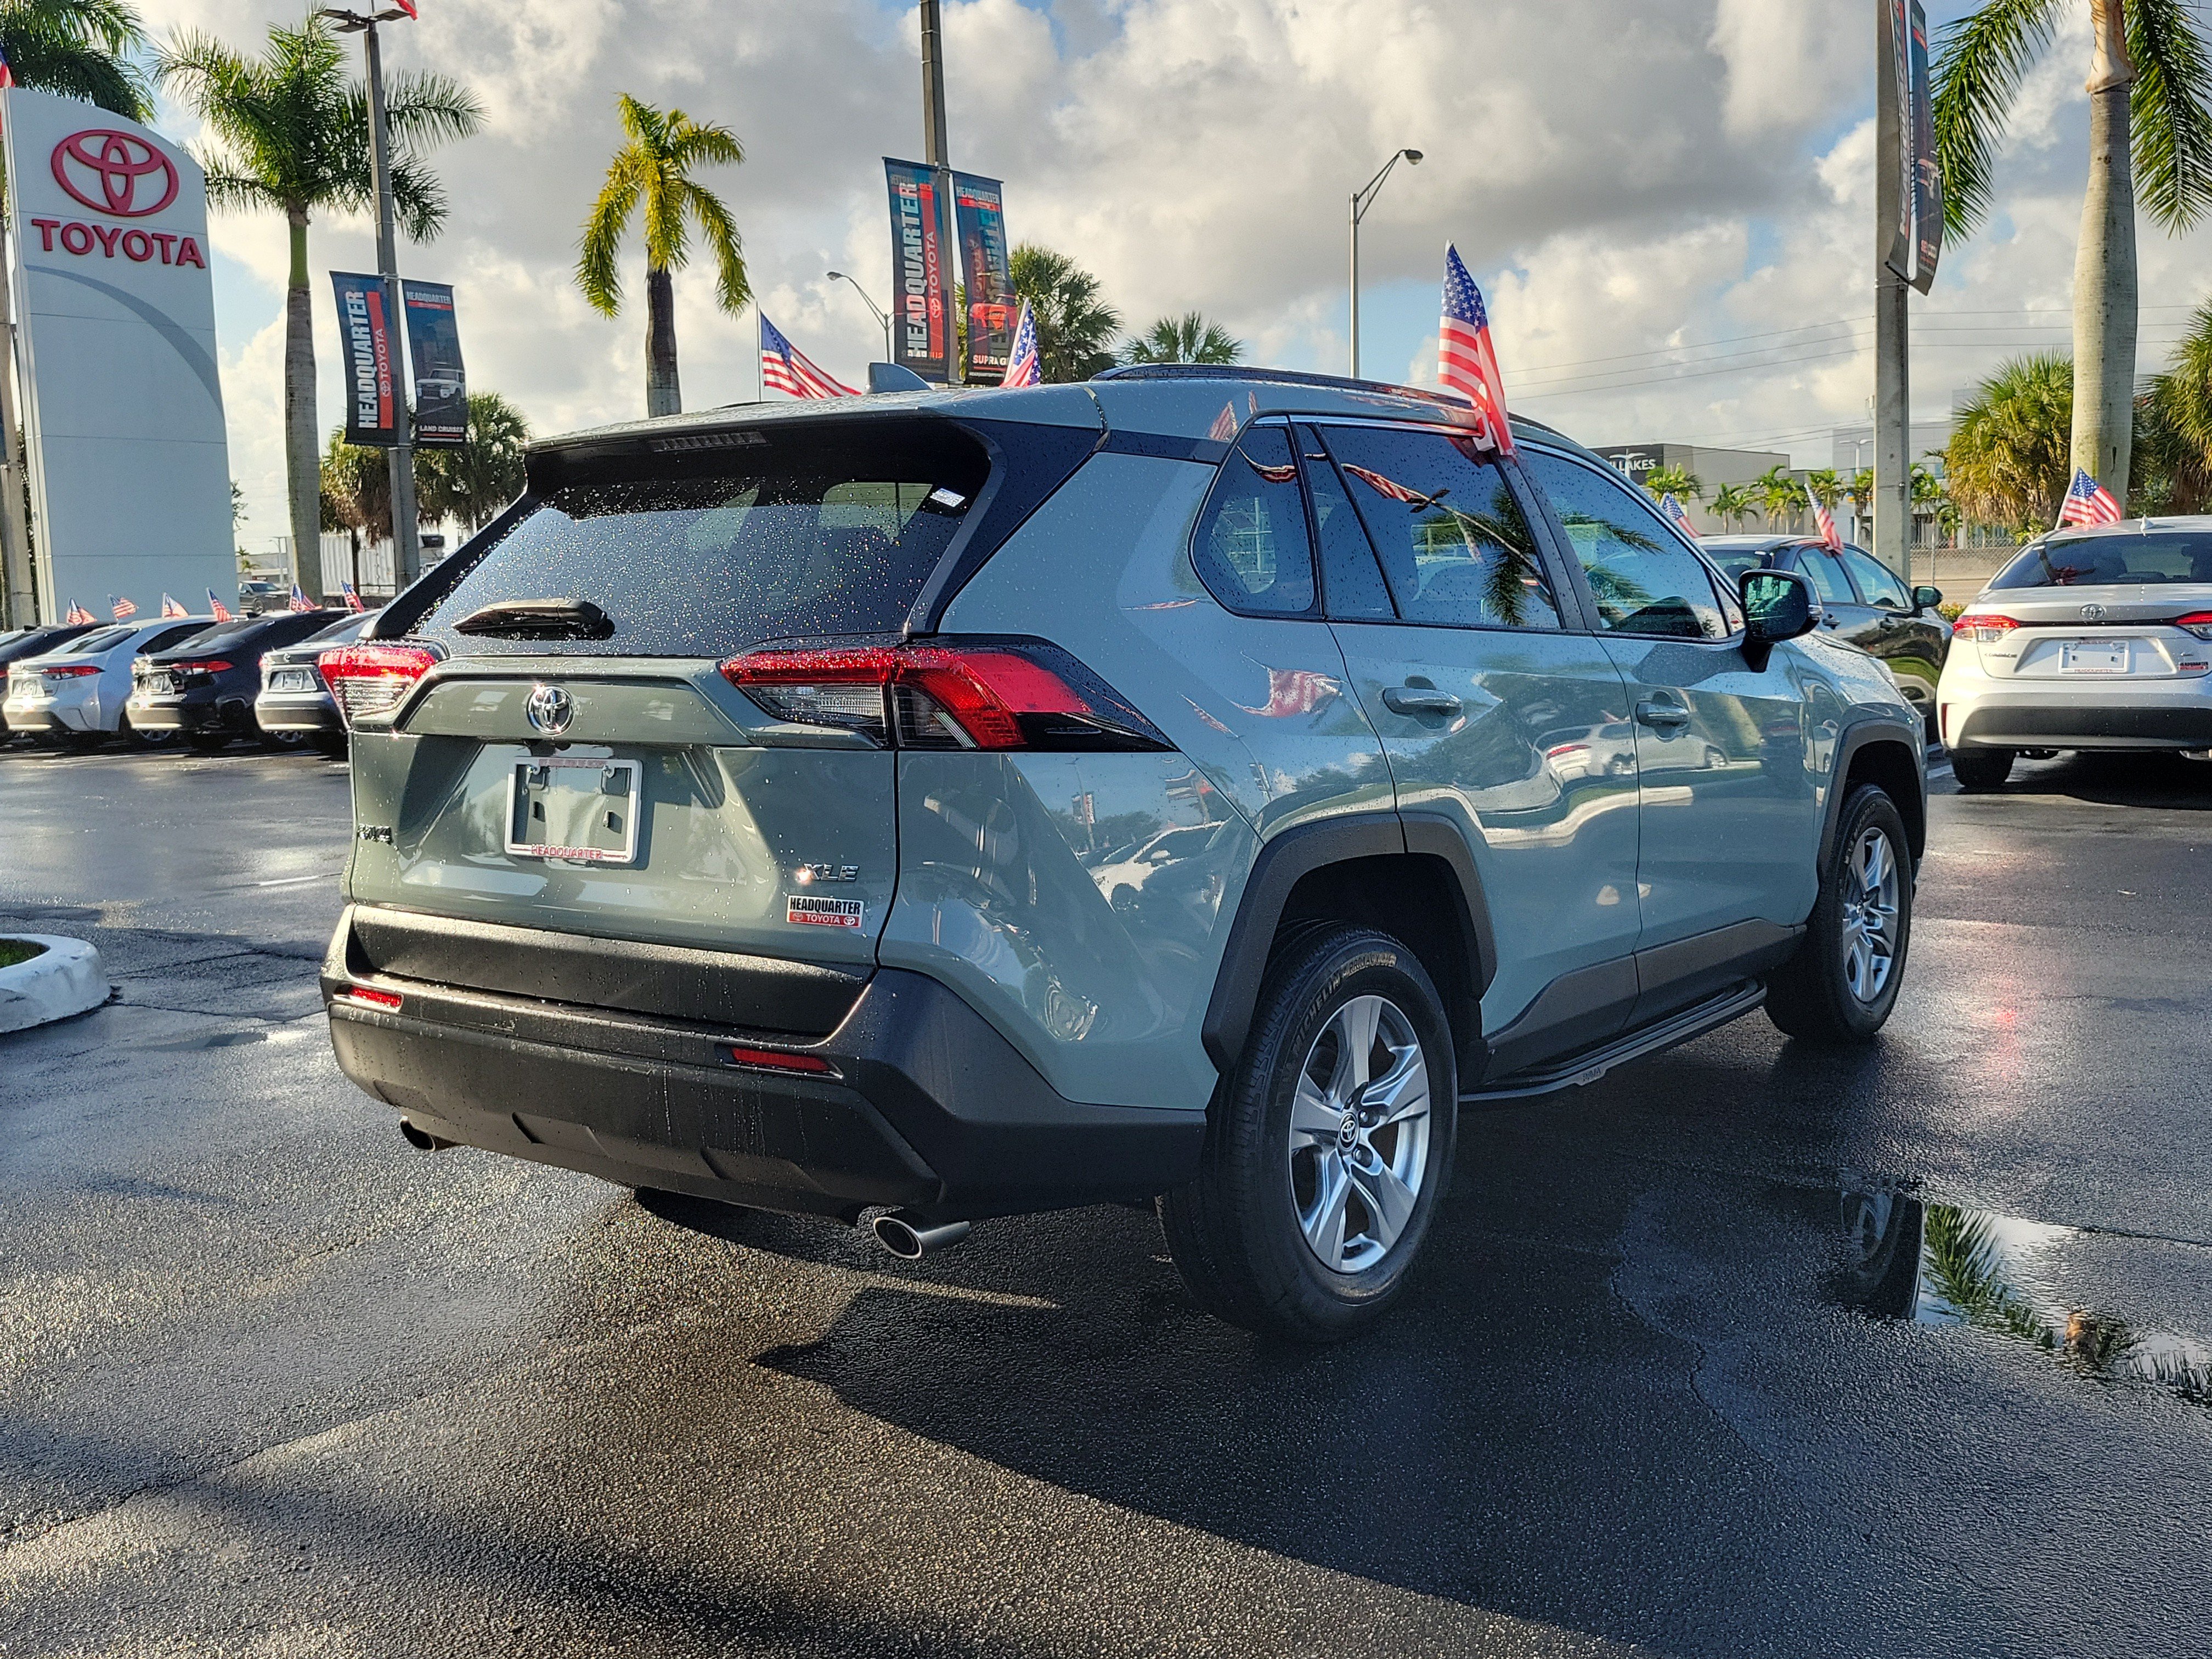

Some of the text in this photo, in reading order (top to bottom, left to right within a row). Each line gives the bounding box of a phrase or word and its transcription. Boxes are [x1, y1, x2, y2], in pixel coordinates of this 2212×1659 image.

[956, 187, 1000, 205] HEADQUARTER
[31, 219, 206, 268] TOYOTA
[900, 182, 927, 358] HEADQUARTER
[925, 231, 939, 296] TOYOTA
[407, 291, 452, 304] HEADQUARTER
[345, 291, 378, 428] HEADQUARTER
[375, 328, 388, 379] TOYOTA
[973, 354, 1010, 366] SUPRA G
[1618, 459, 1656, 471] LAKES
[531, 844, 603, 860] HEADQUARTER
[803, 863, 859, 882] XLE
[790, 897, 861, 916] HEADQUARTER
[806, 913, 840, 924] TOYOTA
[1292, 970, 1341, 1057] MICHELIN
